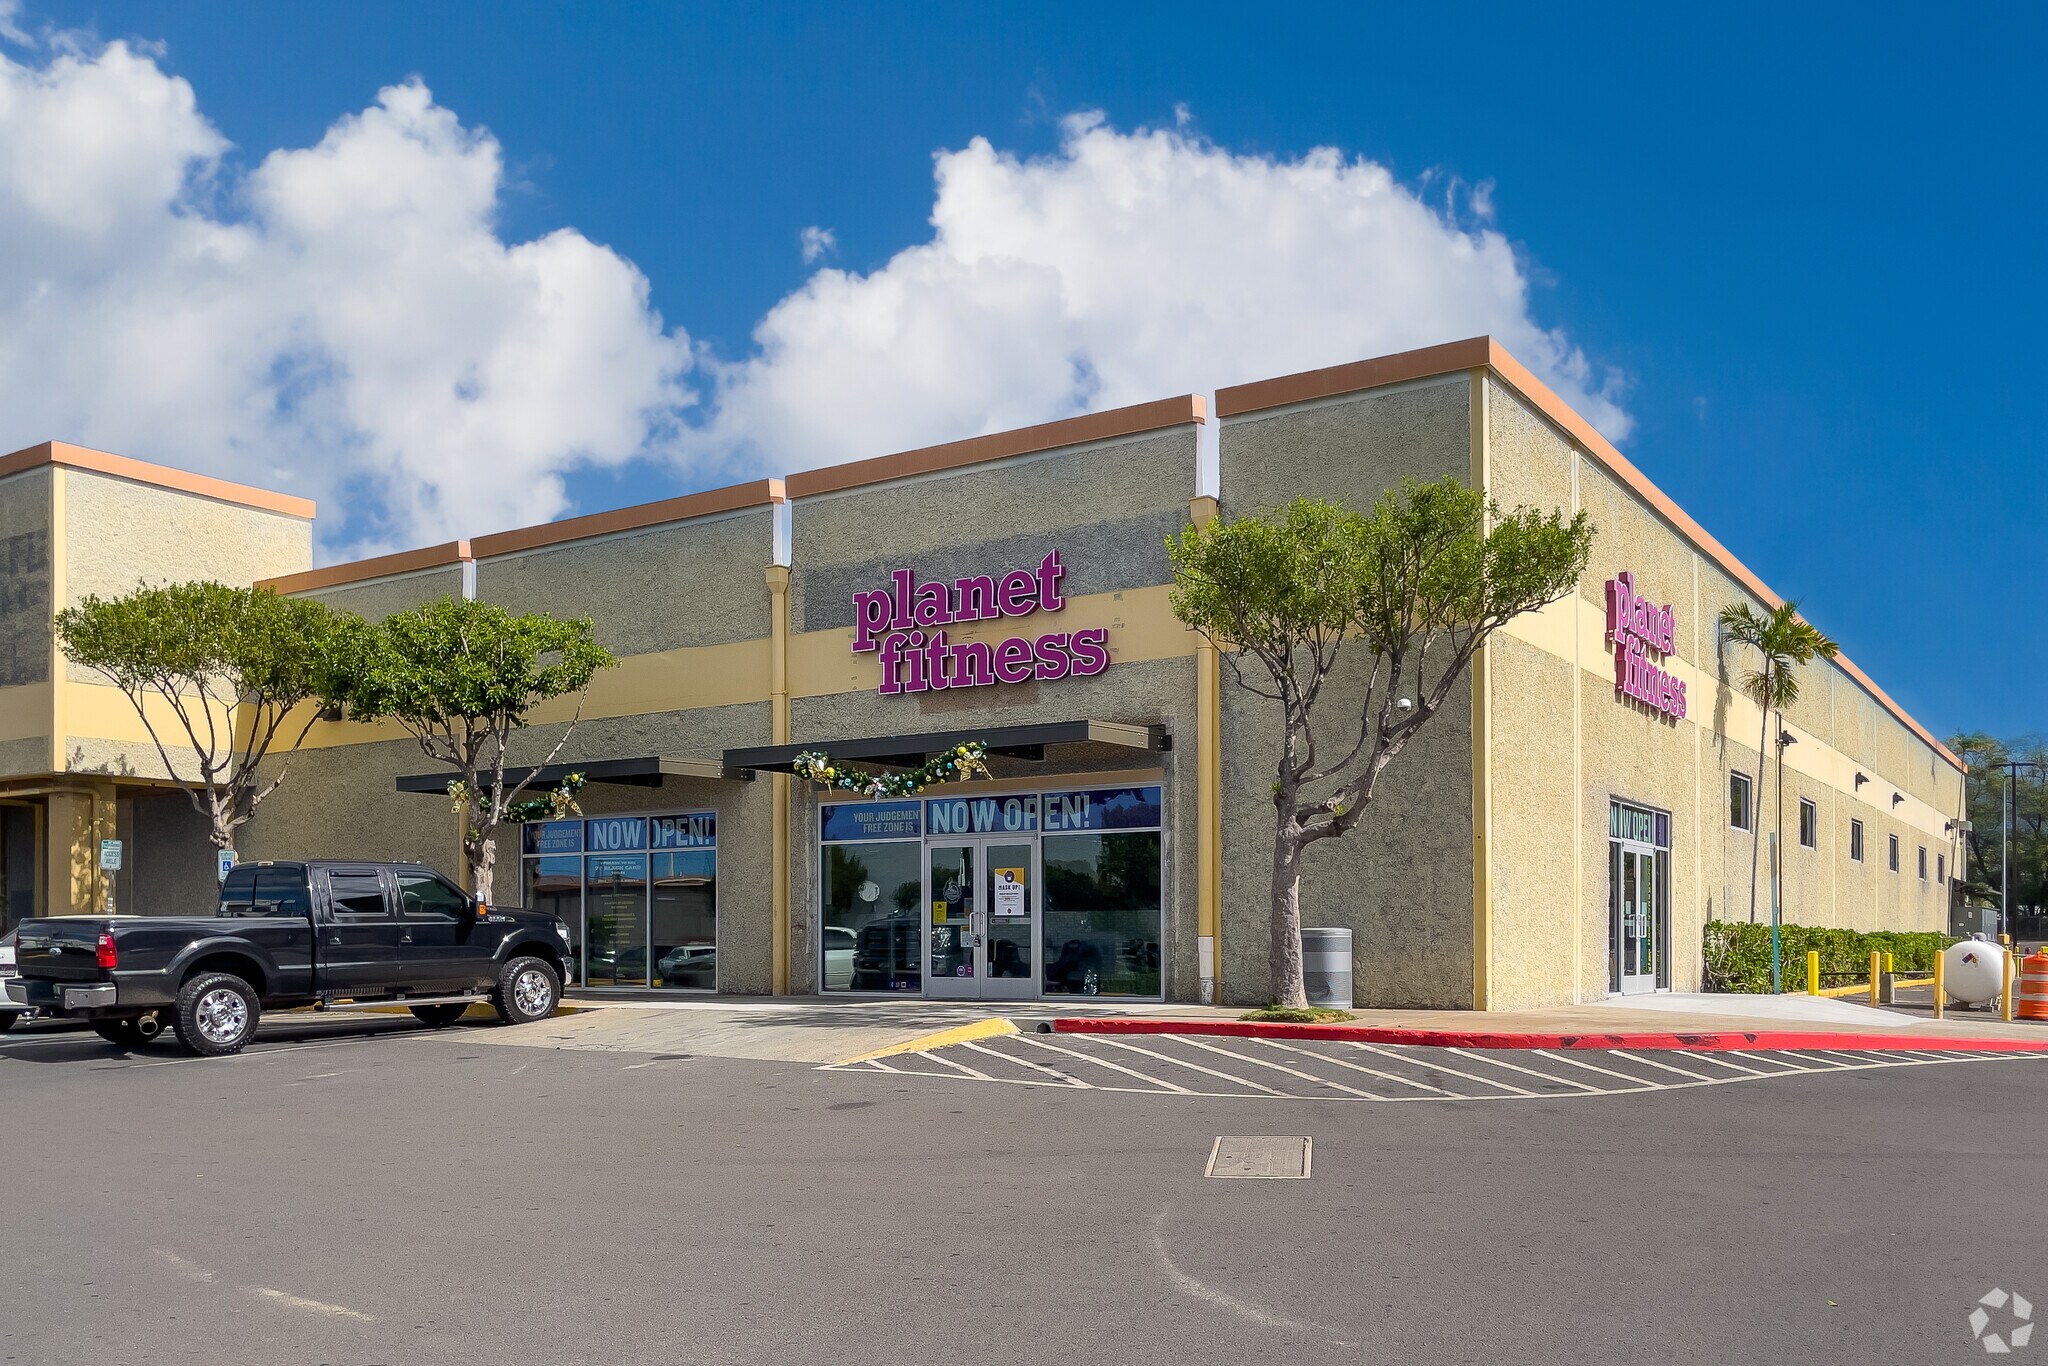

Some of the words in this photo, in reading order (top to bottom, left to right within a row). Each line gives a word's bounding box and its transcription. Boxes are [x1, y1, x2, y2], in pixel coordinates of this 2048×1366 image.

[851, 548, 1066, 653] planet
[1605, 571, 1676, 656] planet
[878, 628, 1111, 695] fitness
[1615, 633, 1686, 719] fitness
[853, 812, 875, 823] YOUR
[863, 821, 882, 833] FREE
[882, 821, 906, 832] ZONE
[905, 820, 914, 832] IS
[932, 799, 997, 834] NOW
[1003, 795, 1089, 831] OPEN!
[1611, 805, 1631, 838] NW
[536, 839, 551, 849] FREE
[551, 838, 567, 848] ZONE
[568, 838, 575, 848] IS
[593, 819, 642, 849] NOW
